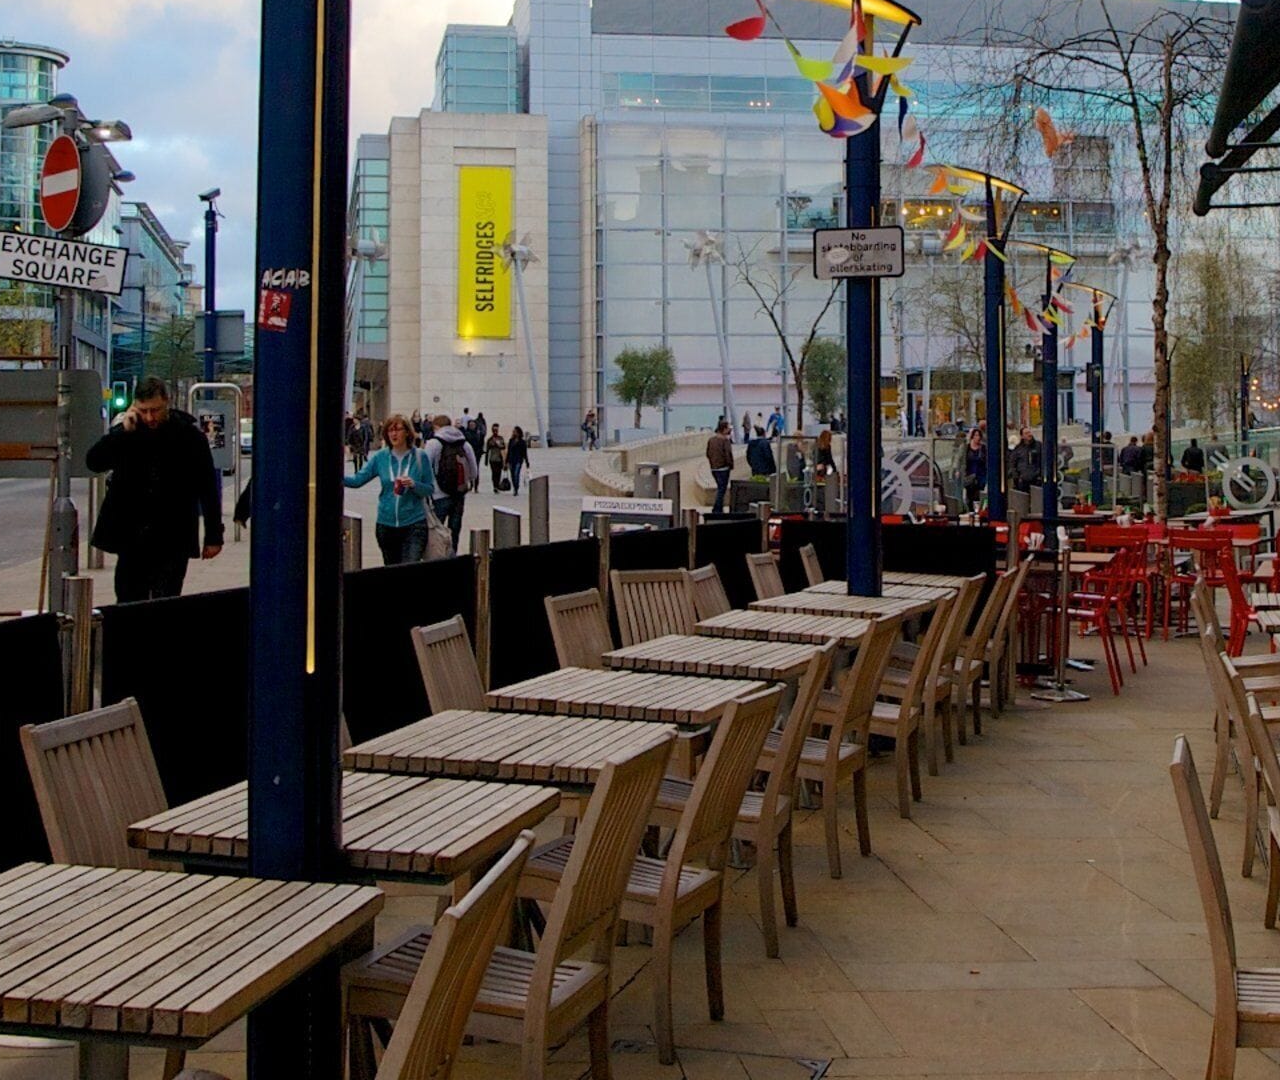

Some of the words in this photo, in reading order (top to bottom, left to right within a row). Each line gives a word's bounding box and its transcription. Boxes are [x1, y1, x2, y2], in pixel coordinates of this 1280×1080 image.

[851, 232, 866, 241] No
[1, 235, 119, 267] EXCHANGE
[853, 253, 864, 262] or
[11, 258, 101, 286] SQUARE
[475, 221, 496, 312] SELFRIDGES
[829, 263, 893, 273] ollerskating
